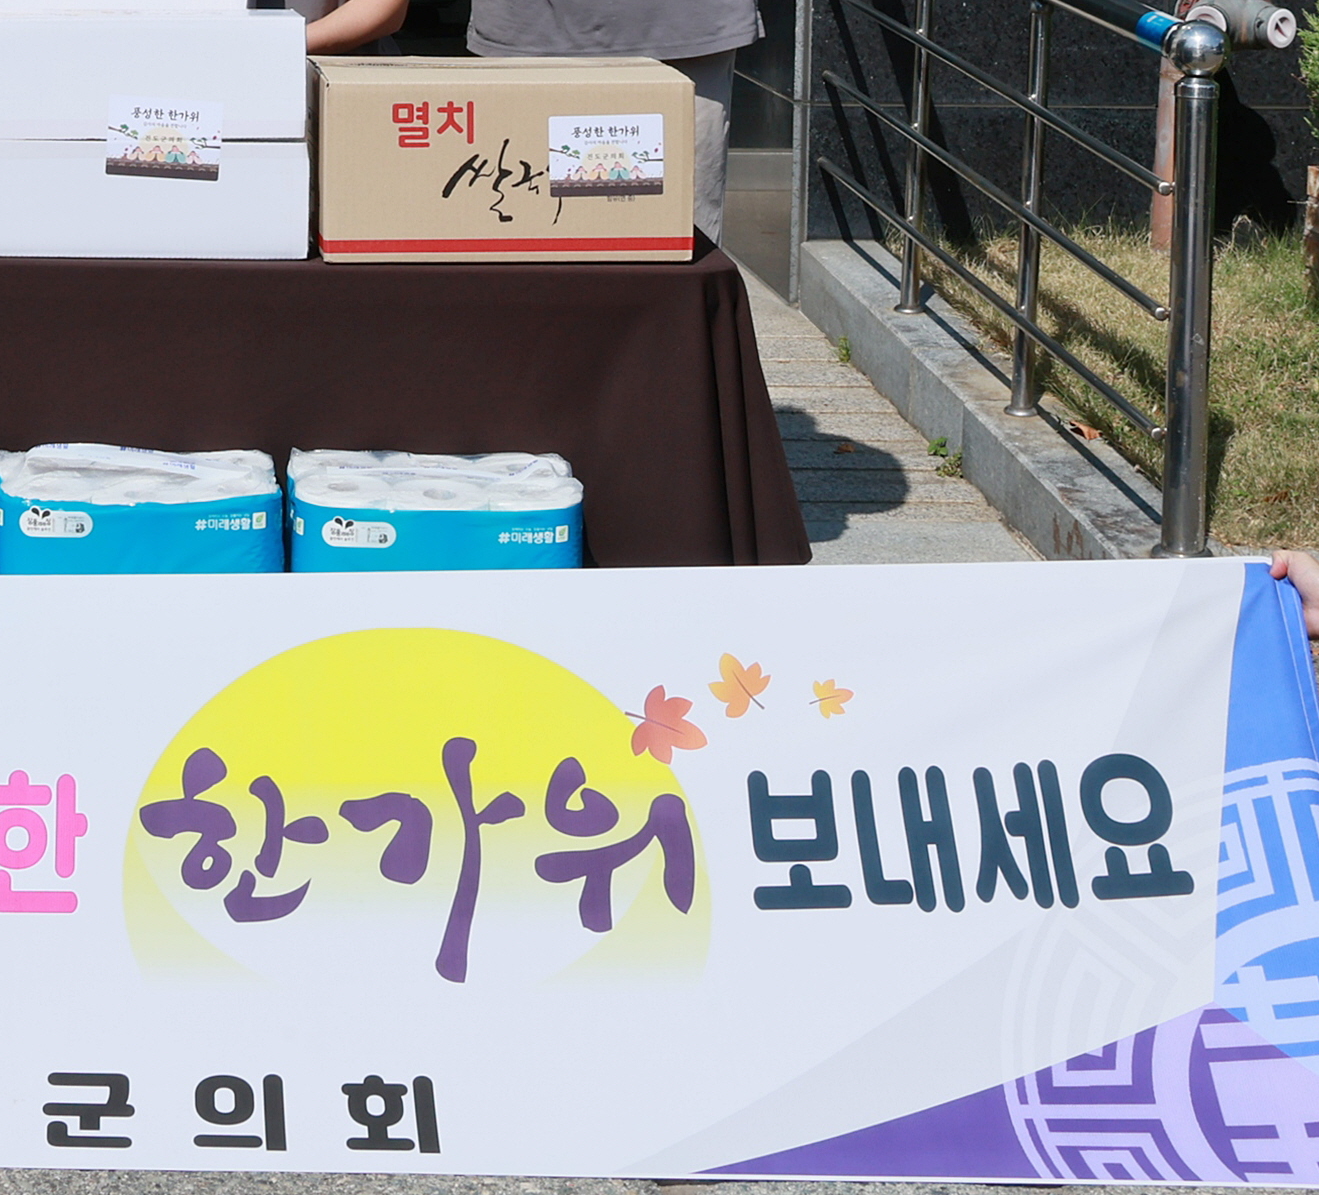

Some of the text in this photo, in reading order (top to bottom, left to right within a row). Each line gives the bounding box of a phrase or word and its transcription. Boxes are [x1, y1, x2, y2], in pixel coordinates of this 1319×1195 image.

[131, 107, 200, 123] 풍성한 한가위
[392, 101, 475, 148] 멸치
[572, 125, 640, 138] 풍성한 한가위
[442, 139, 563, 226] 쌀국
[195, 518, 251, 531] #미래생활
[498, 532, 554, 544] #미래생활
[139, 736, 695, 983] 한가위
[747, 753, 1195, 913] 보내세요
